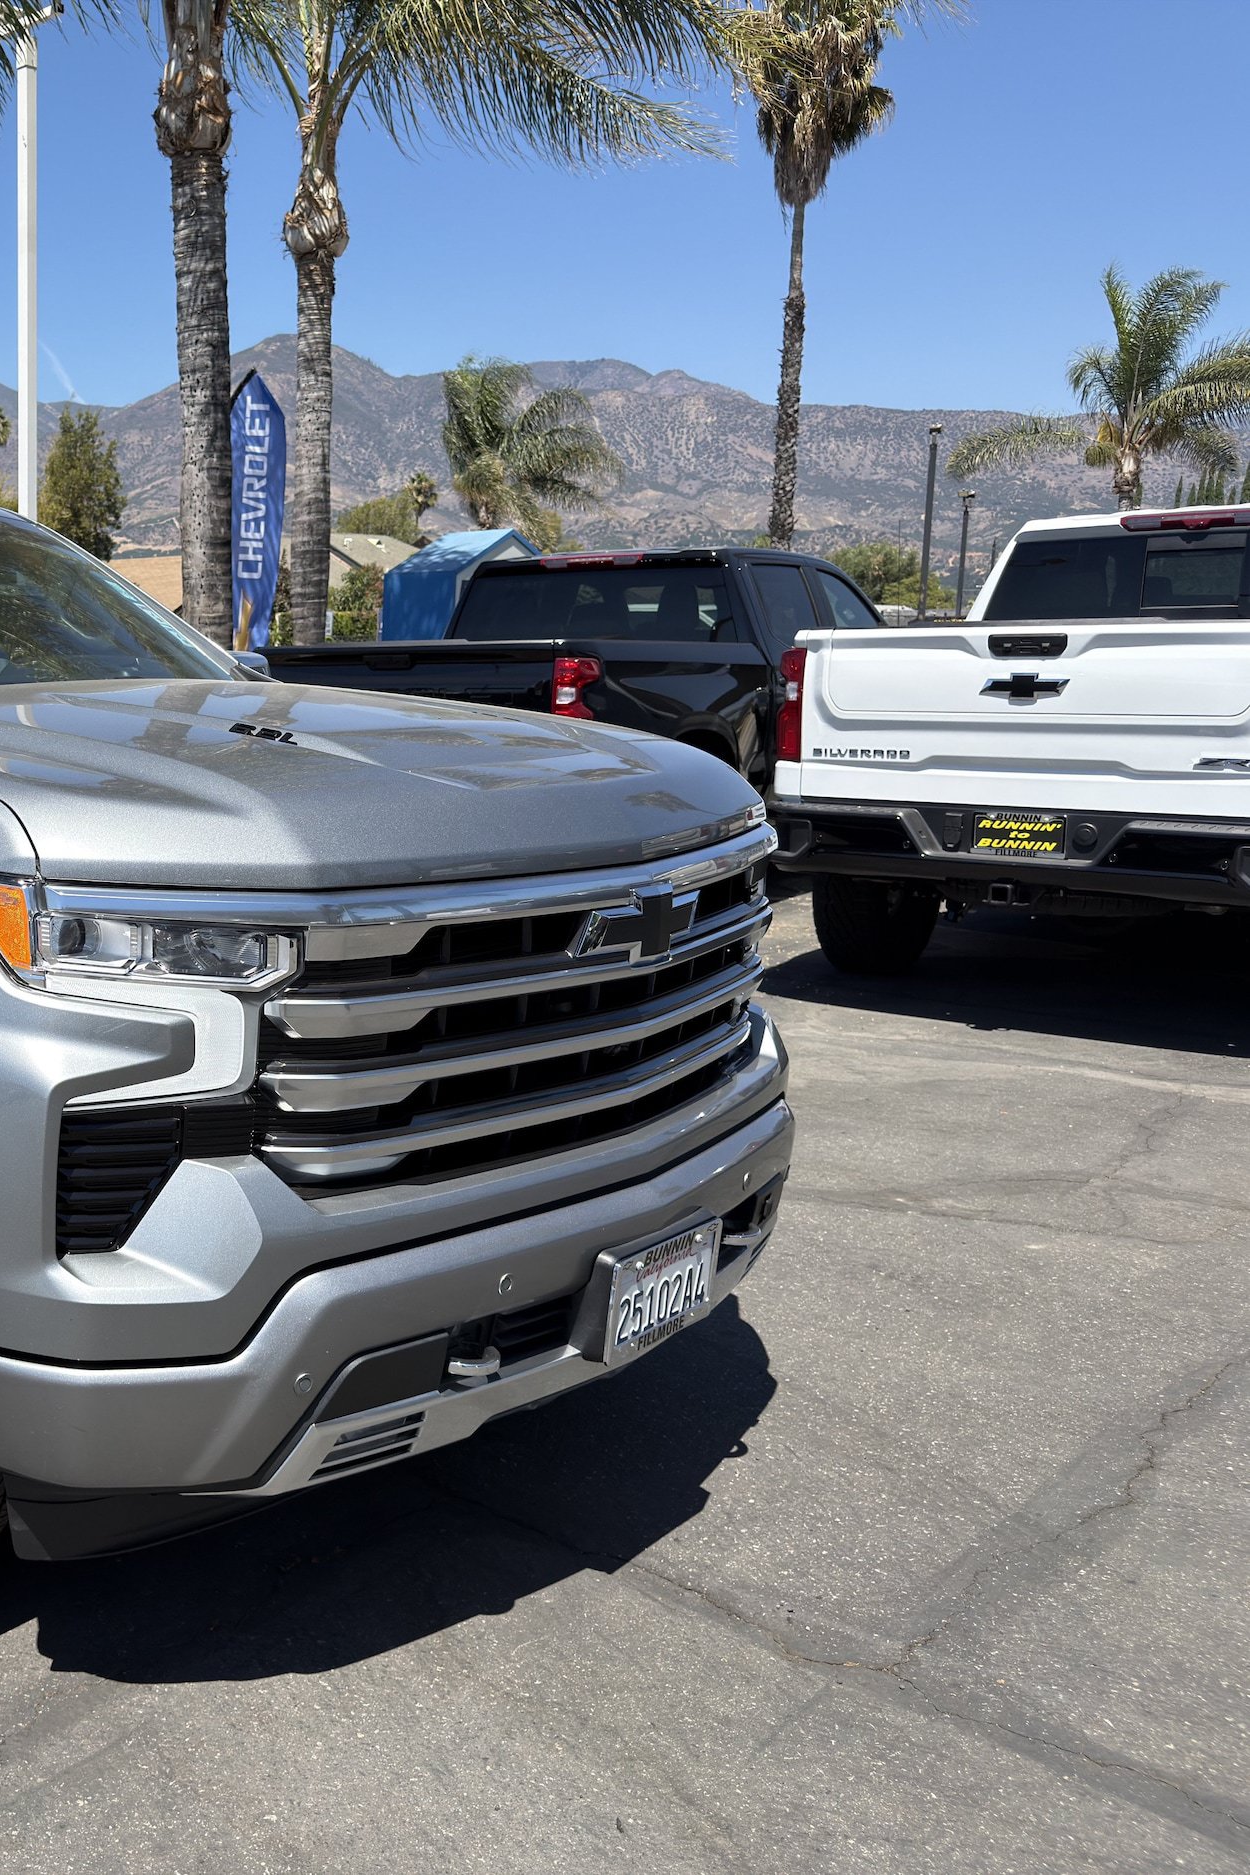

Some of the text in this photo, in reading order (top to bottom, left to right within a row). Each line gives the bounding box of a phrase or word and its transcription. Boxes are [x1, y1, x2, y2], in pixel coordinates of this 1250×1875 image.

[237, 396, 271, 579] CHEVROLET
[812, 748, 910, 760] SILVERADO
[996, 813, 1042, 822] BUNNIN
[978, 819, 1062, 832] RUNNIN'
[977, 837, 1057, 851] BUNNIN
[995, 848, 1038, 857] FILLMORE
[644, 1231, 696, 1266] BUNNIN
[615, 1260, 705, 1345] 25102A4
[637, 1315, 685, 1350] FILLMORE
